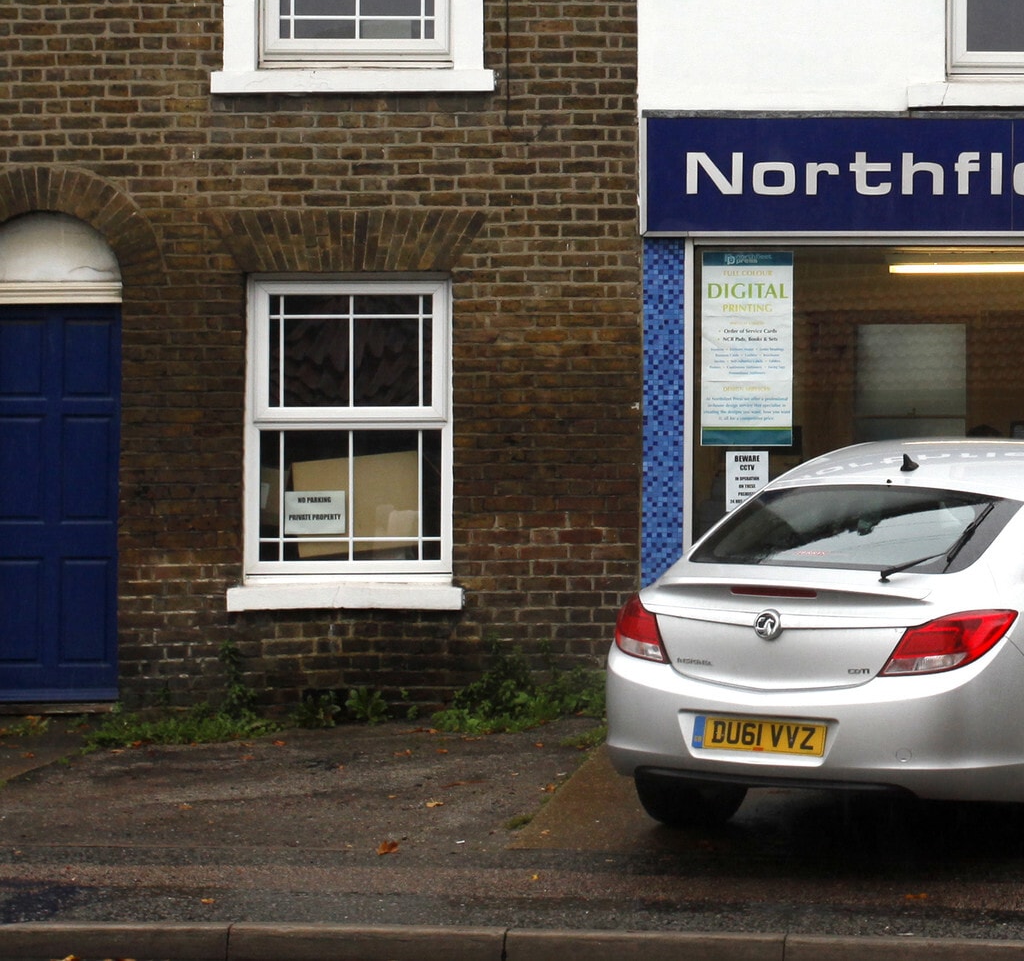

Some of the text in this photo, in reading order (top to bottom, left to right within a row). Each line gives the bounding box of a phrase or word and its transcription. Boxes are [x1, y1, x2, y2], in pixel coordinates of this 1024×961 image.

[707, 283, 789, 299] DIGITAL
[722, 304, 773, 313] PRINTING
[711, 720, 816, 750] DU61 VVZ
